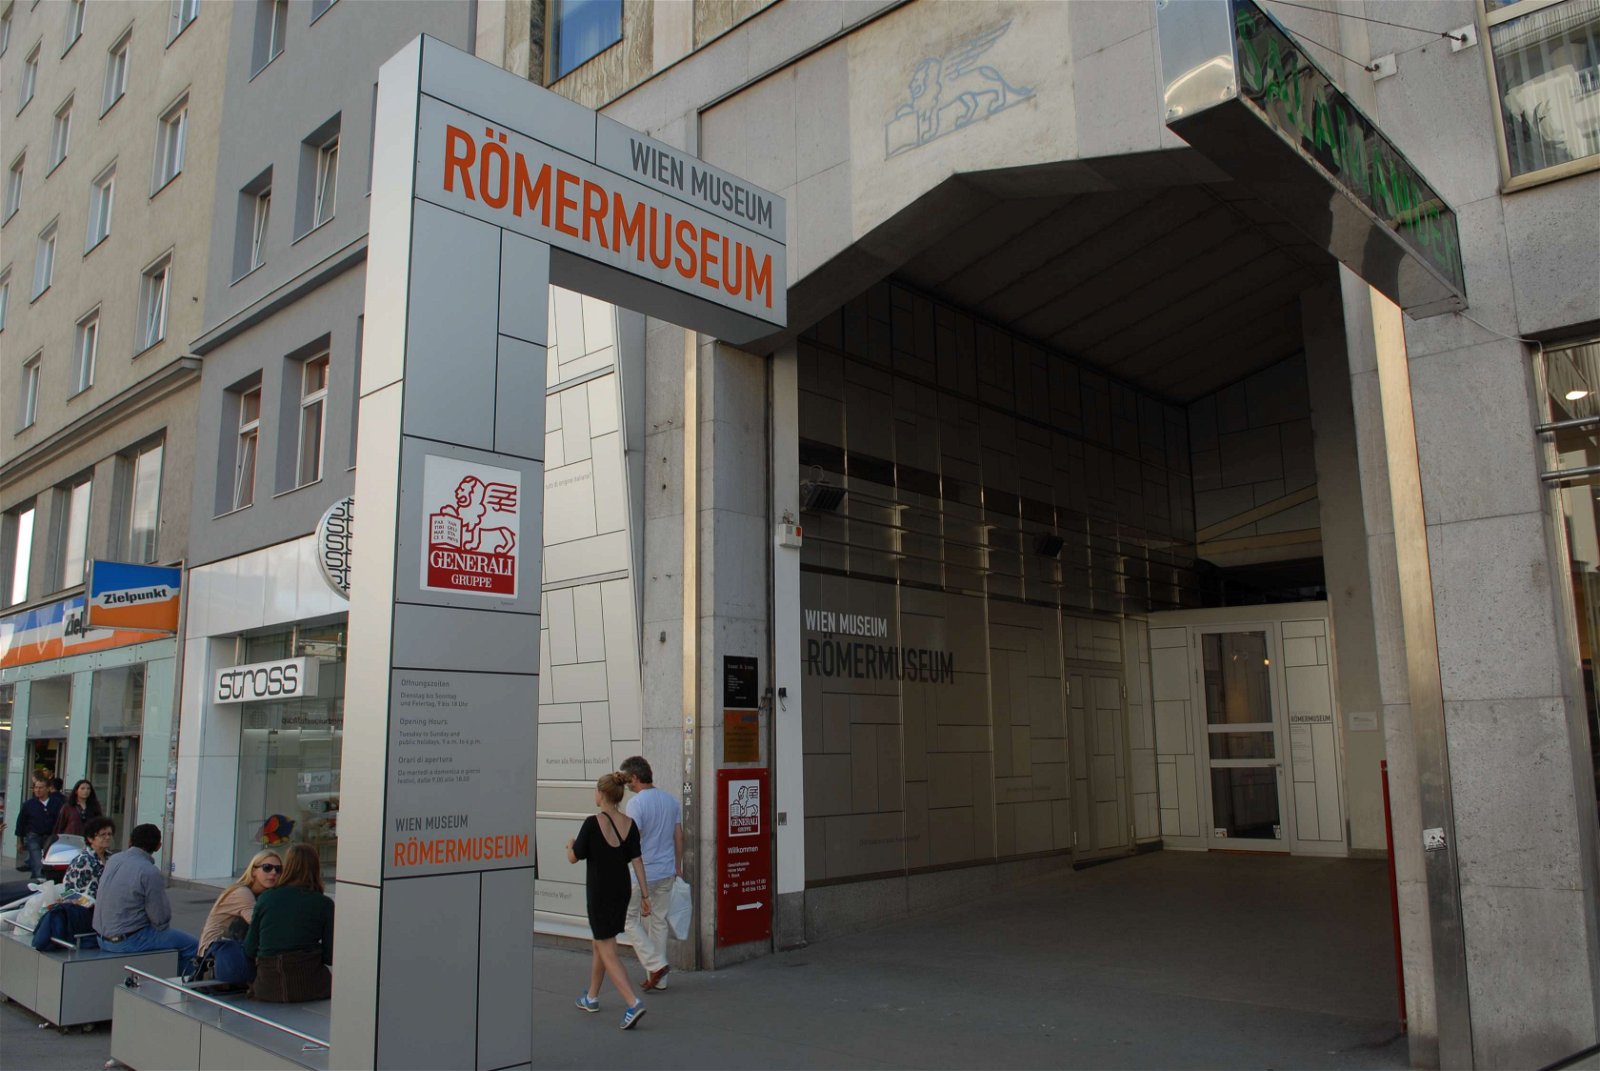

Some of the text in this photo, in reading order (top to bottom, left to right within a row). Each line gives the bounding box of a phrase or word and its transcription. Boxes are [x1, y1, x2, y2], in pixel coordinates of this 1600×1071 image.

[630, 138, 773, 230] WIEN MUSEUM
[443, 124, 772, 309] RÖMERMUSEUM
[430, 551, 513, 576] GENERALI
[451, 574, 492, 588] GRUPPE
[104, 588, 168, 604] Zielpunkt
[805, 609, 888, 638] WIEN MUSEUM
[807, 632, 954, 684] RÖMERMUSEUM
[218, 664, 298, 700] stross
[401, 679, 450, 688] Öffnungszeiten
[399, 718, 427, 726] Opening
[395, 814, 469, 832] WIEN MUSEUM
[730, 817, 758, 827] GENERALI
[394, 833, 529, 867] RÖMERMUSEUM
[727, 846, 759, 854] Willkommen
